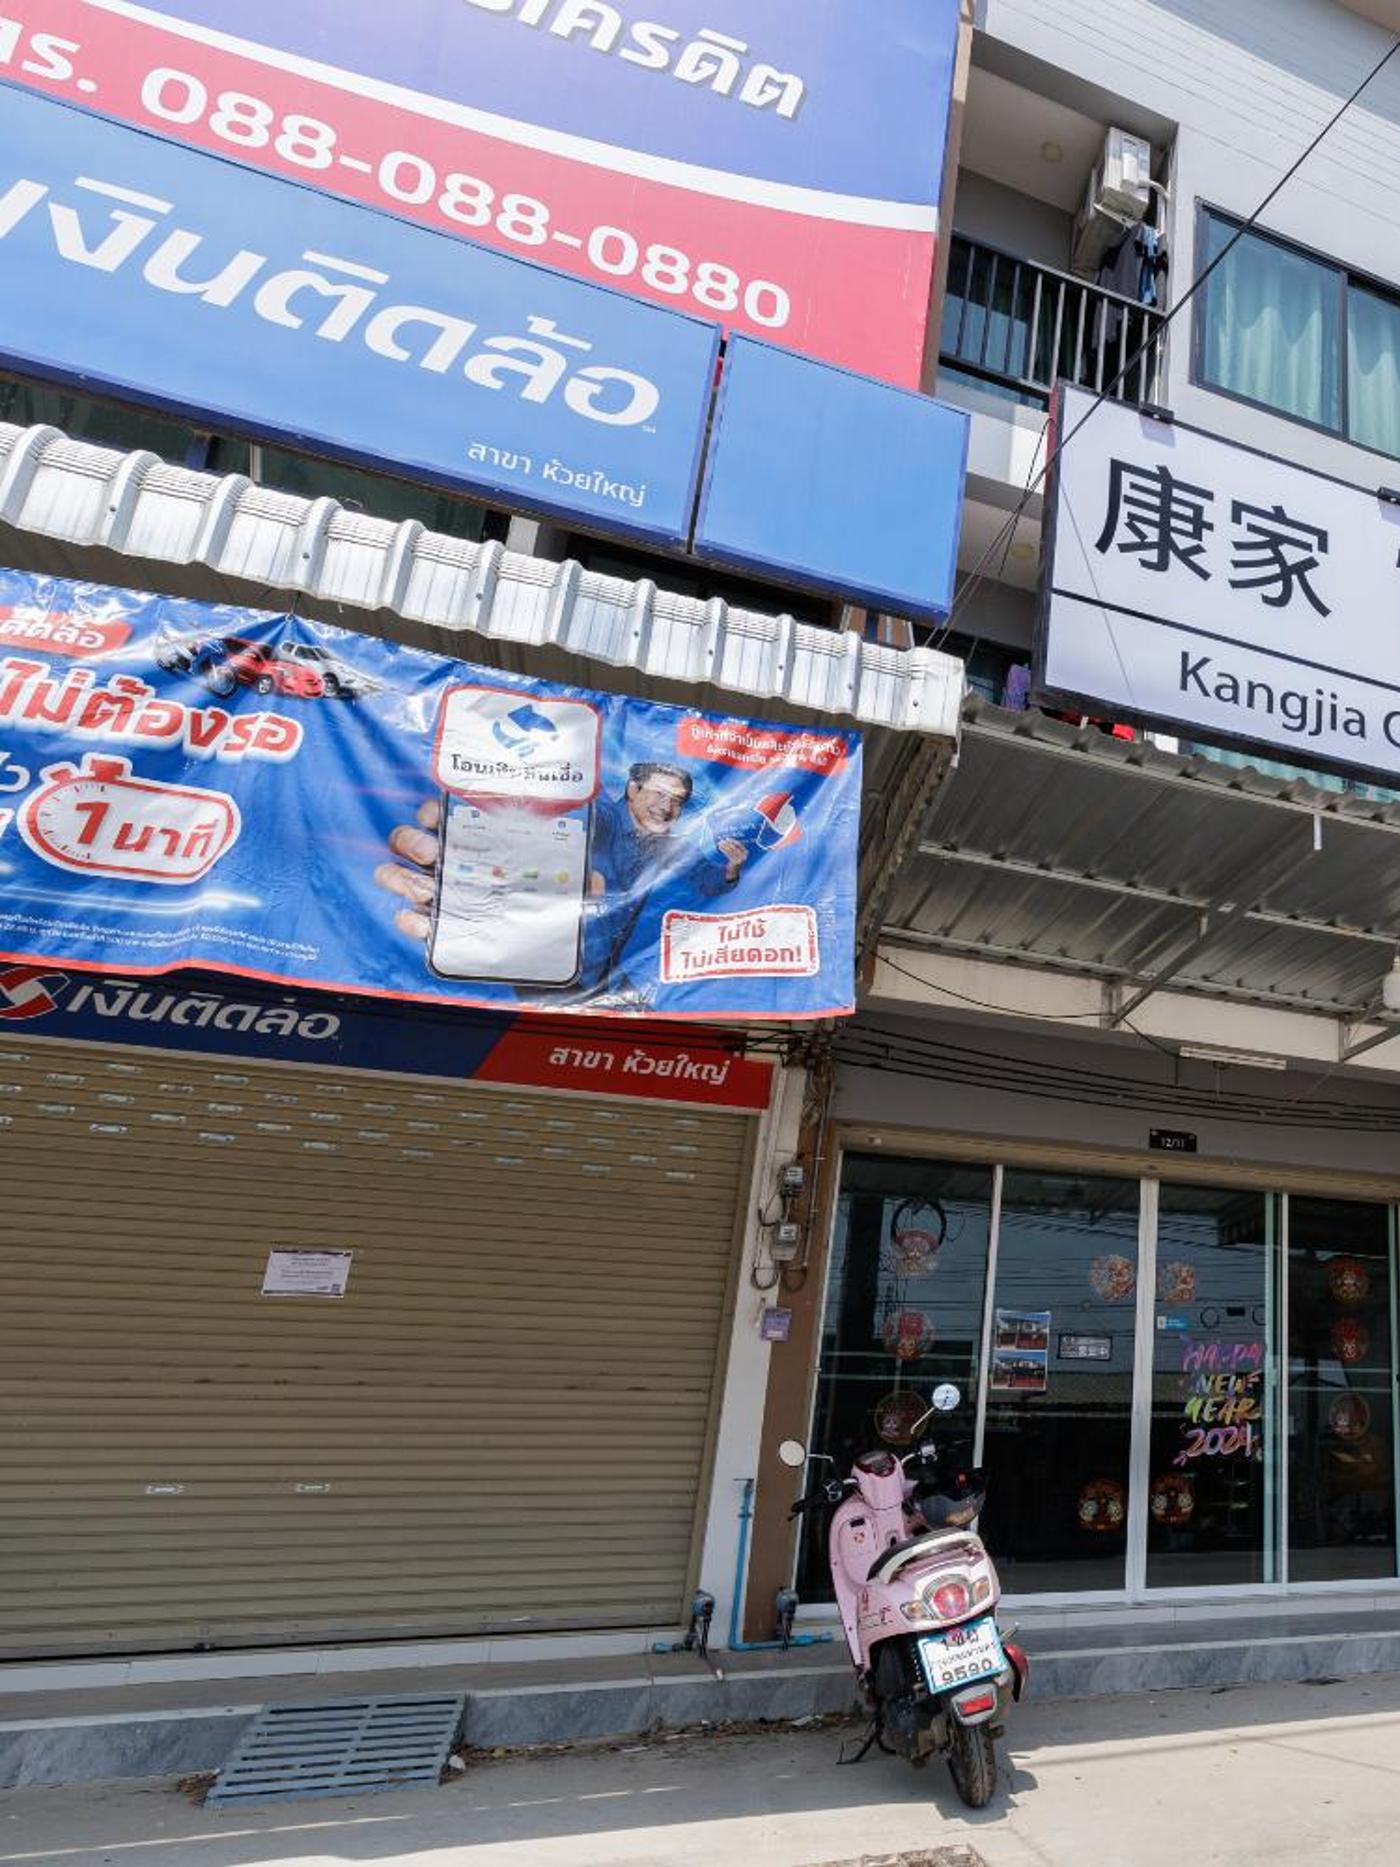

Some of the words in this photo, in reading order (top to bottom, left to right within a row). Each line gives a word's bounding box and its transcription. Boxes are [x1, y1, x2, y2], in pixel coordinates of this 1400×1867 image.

[141, 67, 792, 330] 088-088-0880
[468, 442, 532, 474] สาขา
[543, 458, 647, 508] ห้วยใหญ่
[1096, 459, 1330, 617] 康家
[1180, 651, 1366, 739] Kangjia
[113, 816, 220, 859] นาที
[718, 918, 767, 943] ไม่ใช้
[550, 1047, 614, 1071] สาขา
[623, 1050, 731, 1086] ห้วยใหญ่
